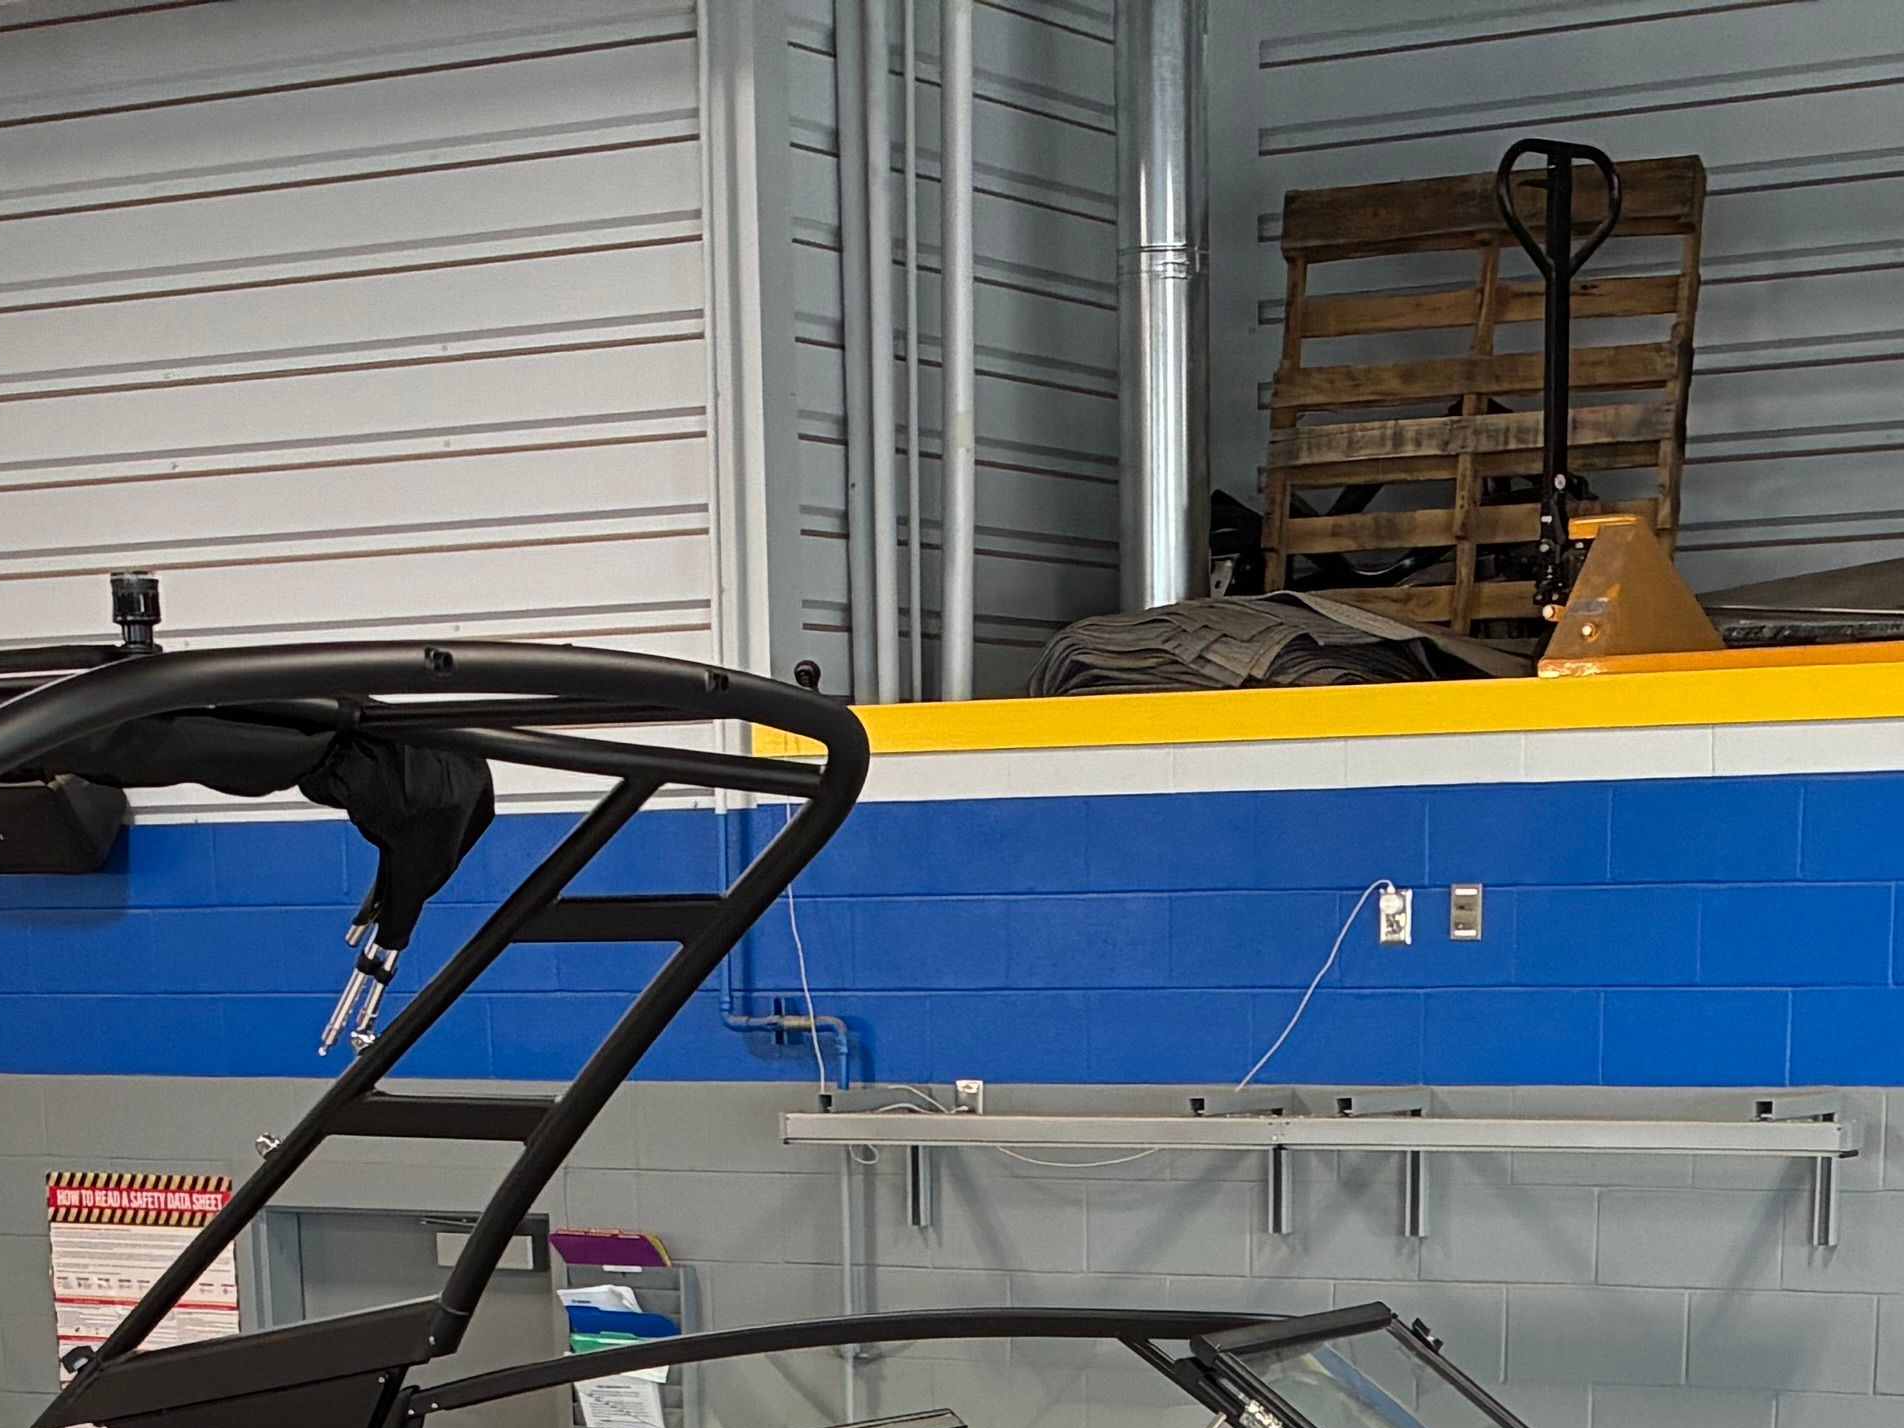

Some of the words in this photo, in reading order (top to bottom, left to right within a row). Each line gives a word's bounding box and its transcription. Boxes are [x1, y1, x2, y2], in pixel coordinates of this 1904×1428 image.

[56, 1189, 80, 1207] HOW
[81, 1190, 94, 1207] TO
[96, 1190, 120, 1208] READ
[122, 1192, 129, 1207] A
[130, 1192, 165, 1209] SAFETY
[167, 1193, 192, 1210] DATA
[192, 1194, 223, 1211] SHEET
